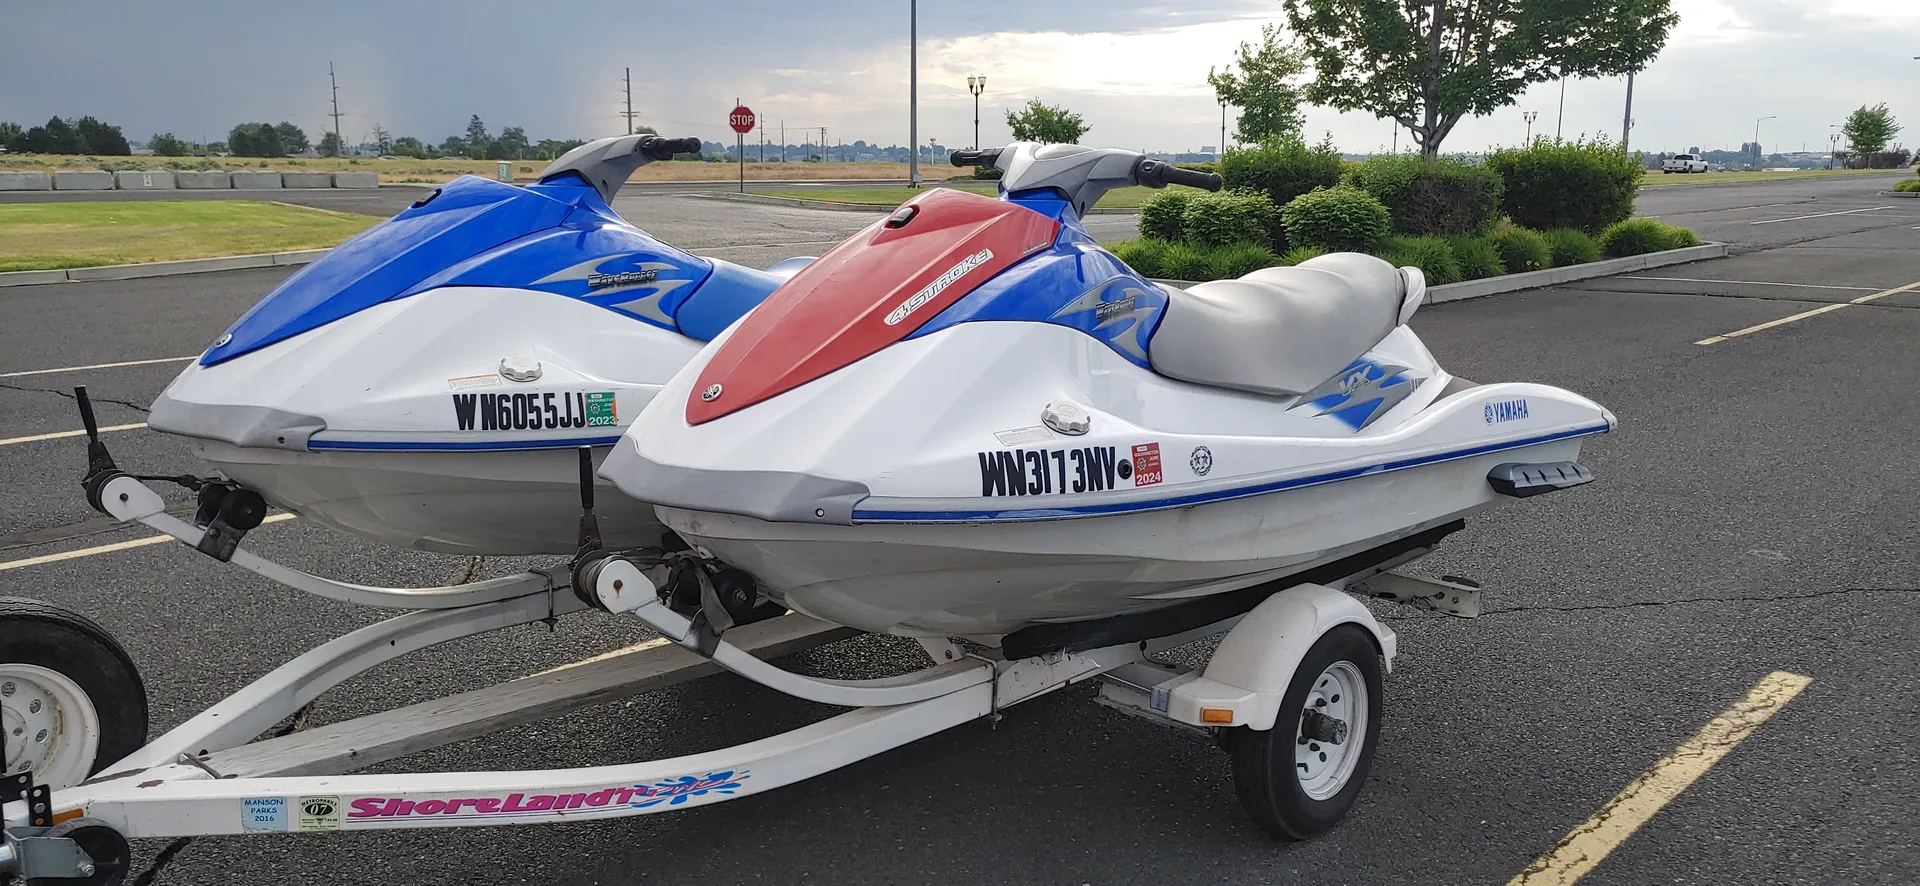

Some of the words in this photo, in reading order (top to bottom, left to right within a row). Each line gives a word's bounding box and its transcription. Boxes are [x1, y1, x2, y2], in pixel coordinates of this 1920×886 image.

[731, 114, 754, 126] STOP
[1337, 364, 1372, 396] VX
[1492, 399, 1529, 424] YAMAHA
[589, 416, 615, 426] 2023
[1136, 471, 1161, 485] 2024
[301, 798, 338, 807] METROPARKS
[310, 804, 328, 815] 07
